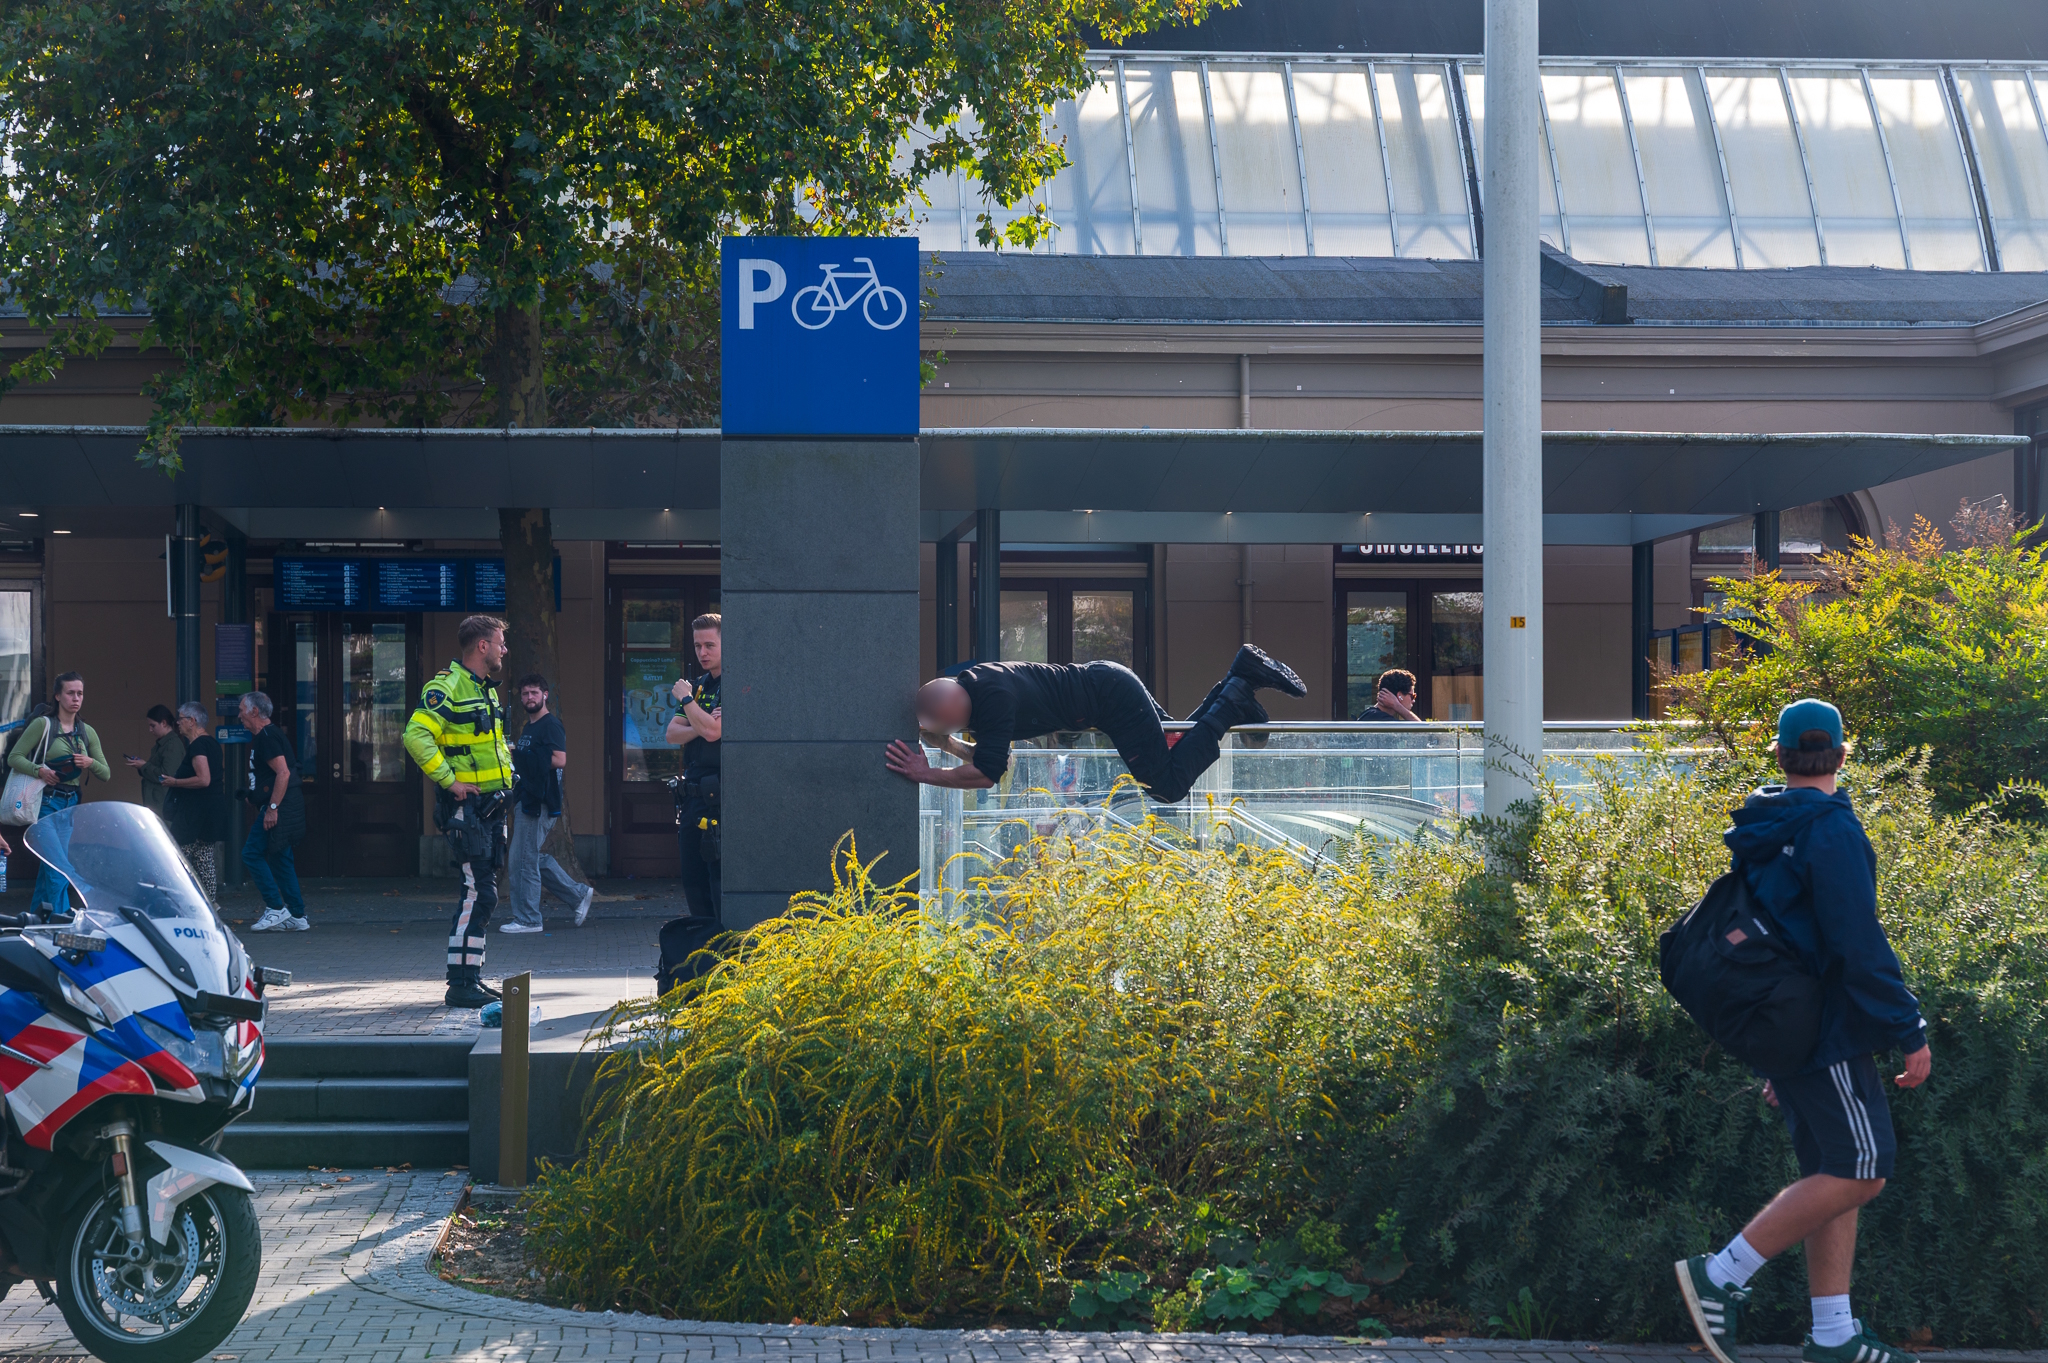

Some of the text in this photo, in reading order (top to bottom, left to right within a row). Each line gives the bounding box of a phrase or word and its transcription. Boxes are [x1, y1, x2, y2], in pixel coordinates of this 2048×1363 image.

[739, 259, 787, 330] P
[1513, 617, 1525, 628] 15
[174, 928, 221, 945] POLITIE
